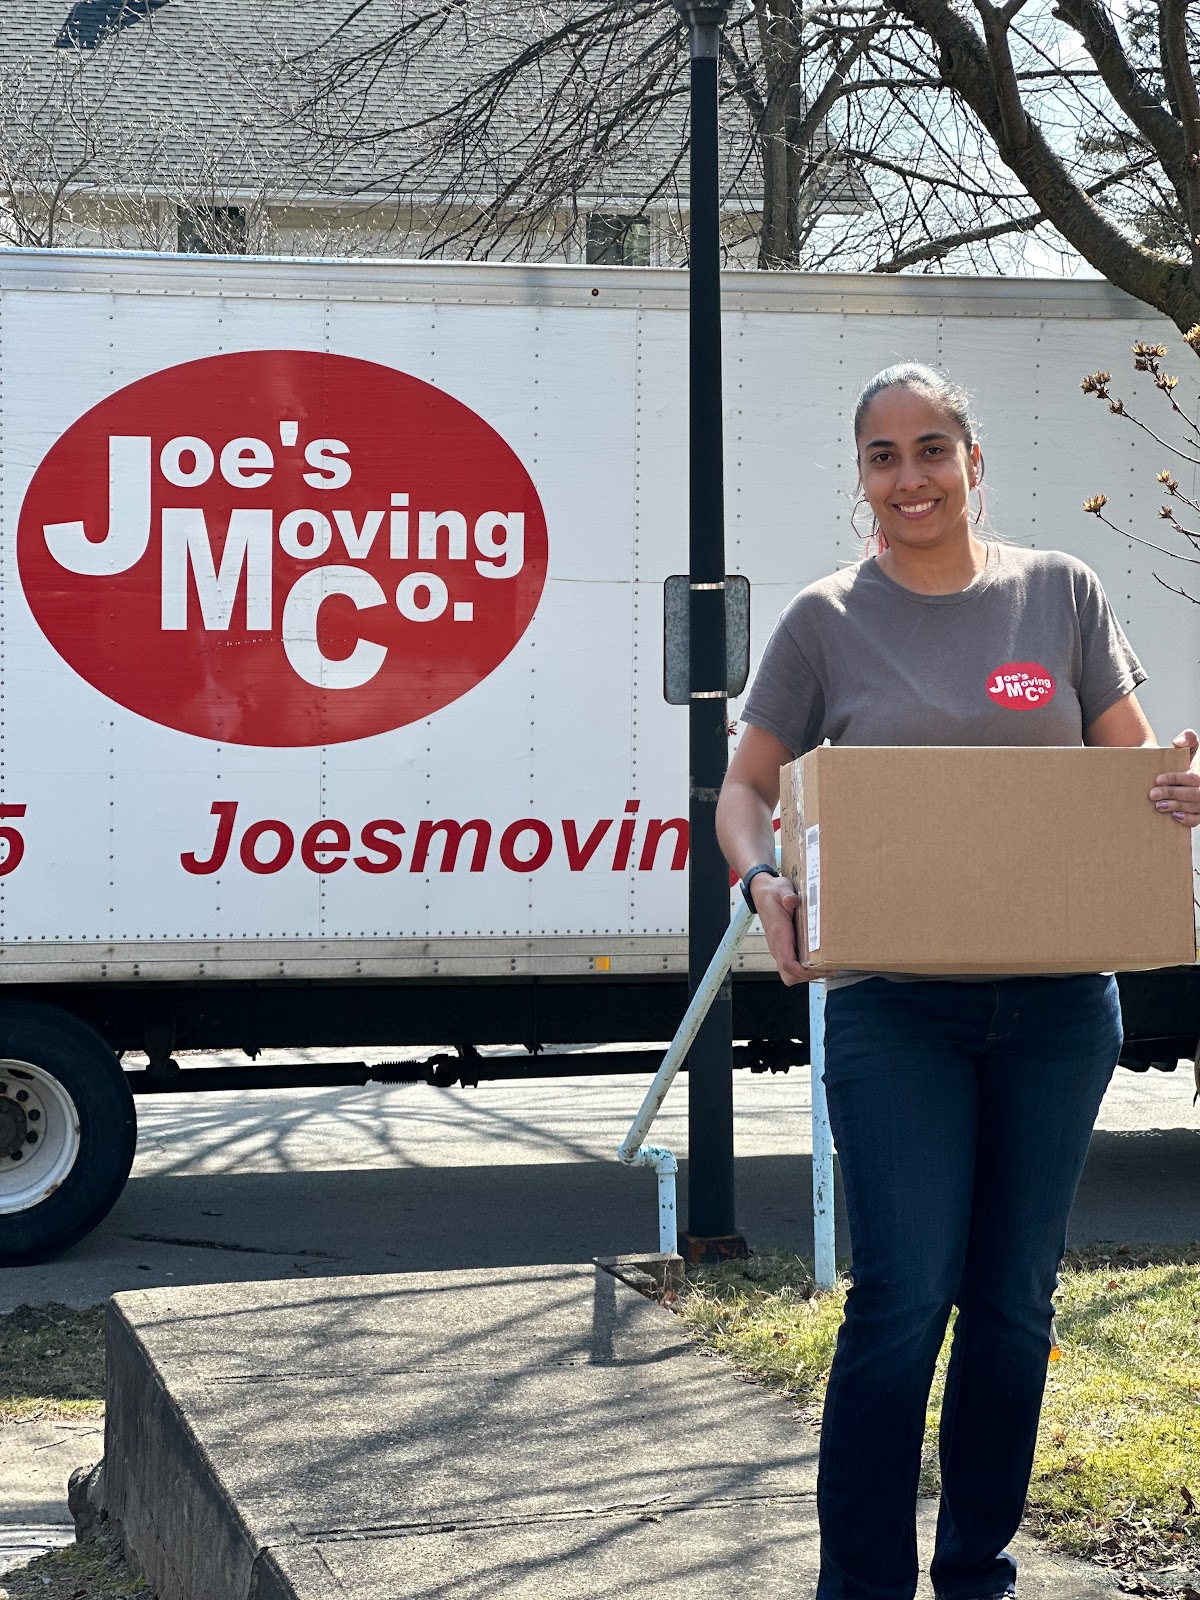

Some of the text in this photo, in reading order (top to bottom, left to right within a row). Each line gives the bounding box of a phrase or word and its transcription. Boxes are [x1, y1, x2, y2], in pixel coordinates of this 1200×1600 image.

[43, 421, 352, 577] Joe's
[161, 493, 526, 631] Moving
[281, 565, 474, 690] Co.
[989, 673, 1029, 693] Joe's
[1005, 677, 1051, 698] Moving
[1025, 687, 1048, 701] Co.
[181, 800, 740, 888] Joesmovin
